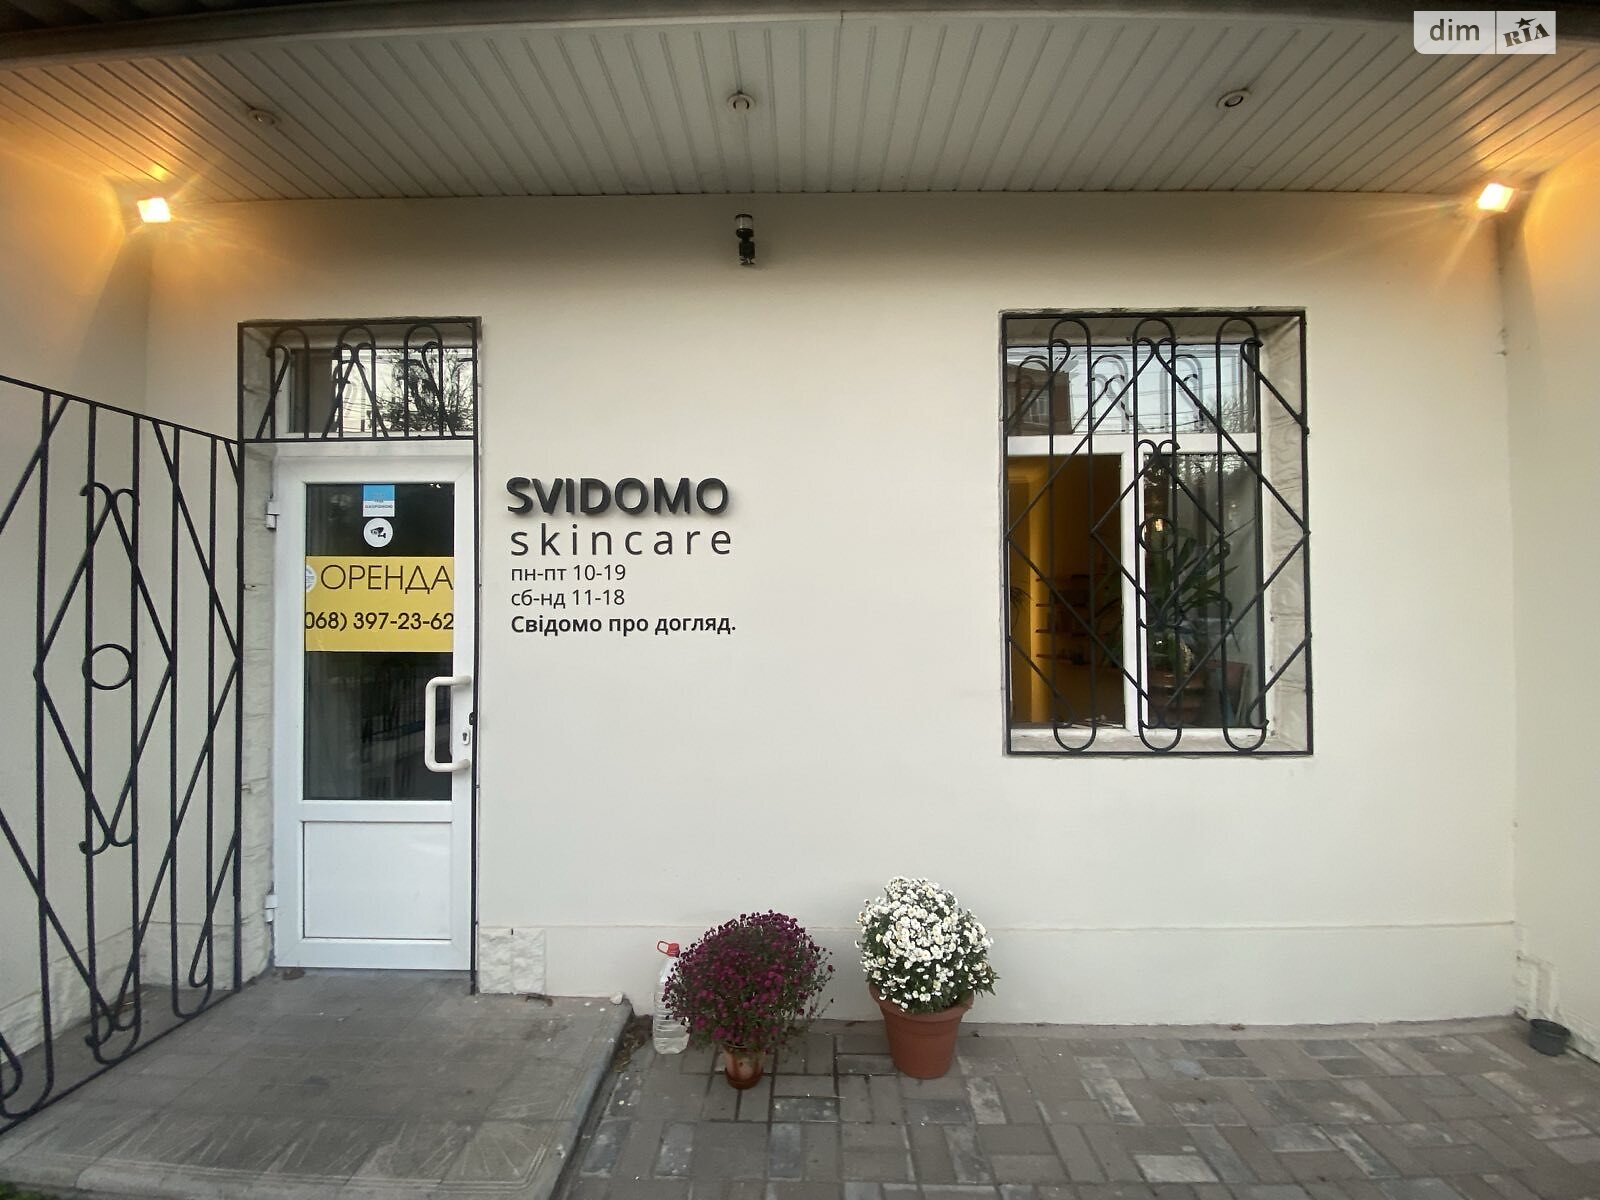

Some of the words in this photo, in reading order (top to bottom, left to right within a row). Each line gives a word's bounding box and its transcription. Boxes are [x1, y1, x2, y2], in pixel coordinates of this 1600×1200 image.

[506, 477, 730, 514] SVIDOMO
[510, 523, 731, 555] skincare
[321, 564, 454, 594] ОРЕНДА
[511, 568, 567, 581] пн-пт
[573, 564, 626, 581] 10-19
[511, 589, 566, 609] сб-нд
[572, 589, 625, 606] 11-18
[353, 612, 454, 630] 397-23-62
[511, 615, 602, 636] Свідомо
[609, 617, 649, 637] про
[655, 617, 736, 636] догляд.
